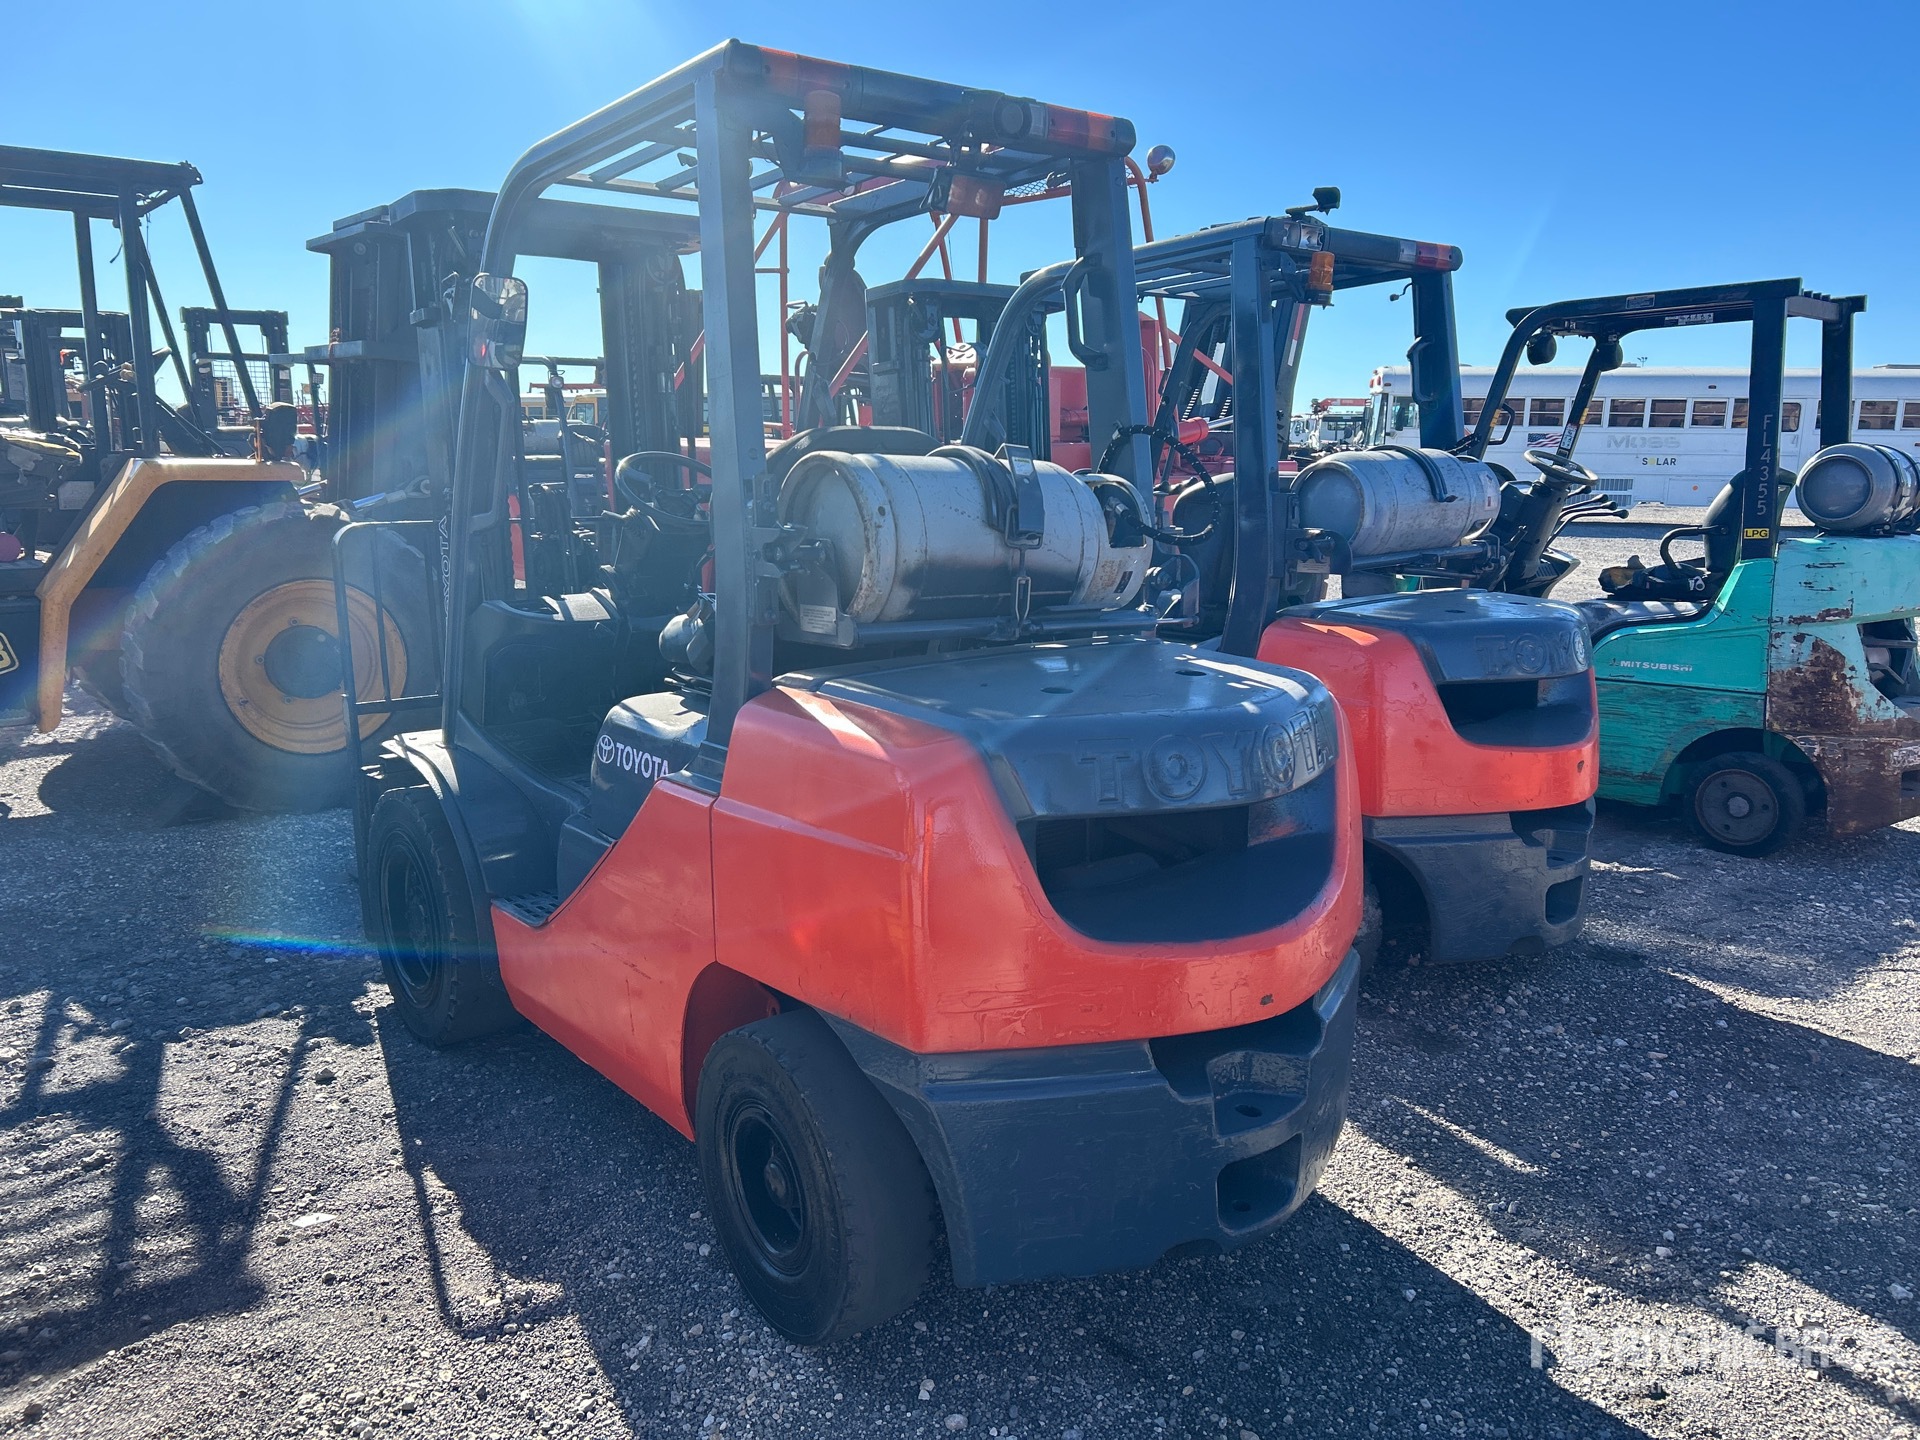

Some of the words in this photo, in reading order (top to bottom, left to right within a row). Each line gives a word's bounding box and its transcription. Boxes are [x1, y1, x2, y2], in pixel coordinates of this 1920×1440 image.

[1757, 414, 1773, 515] FL4355
[1745, 529, 1768, 538] LPG
[1620, 660, 1693, 672] MITSUBISHI
[616, 742, 669, 781] TOYOTA
